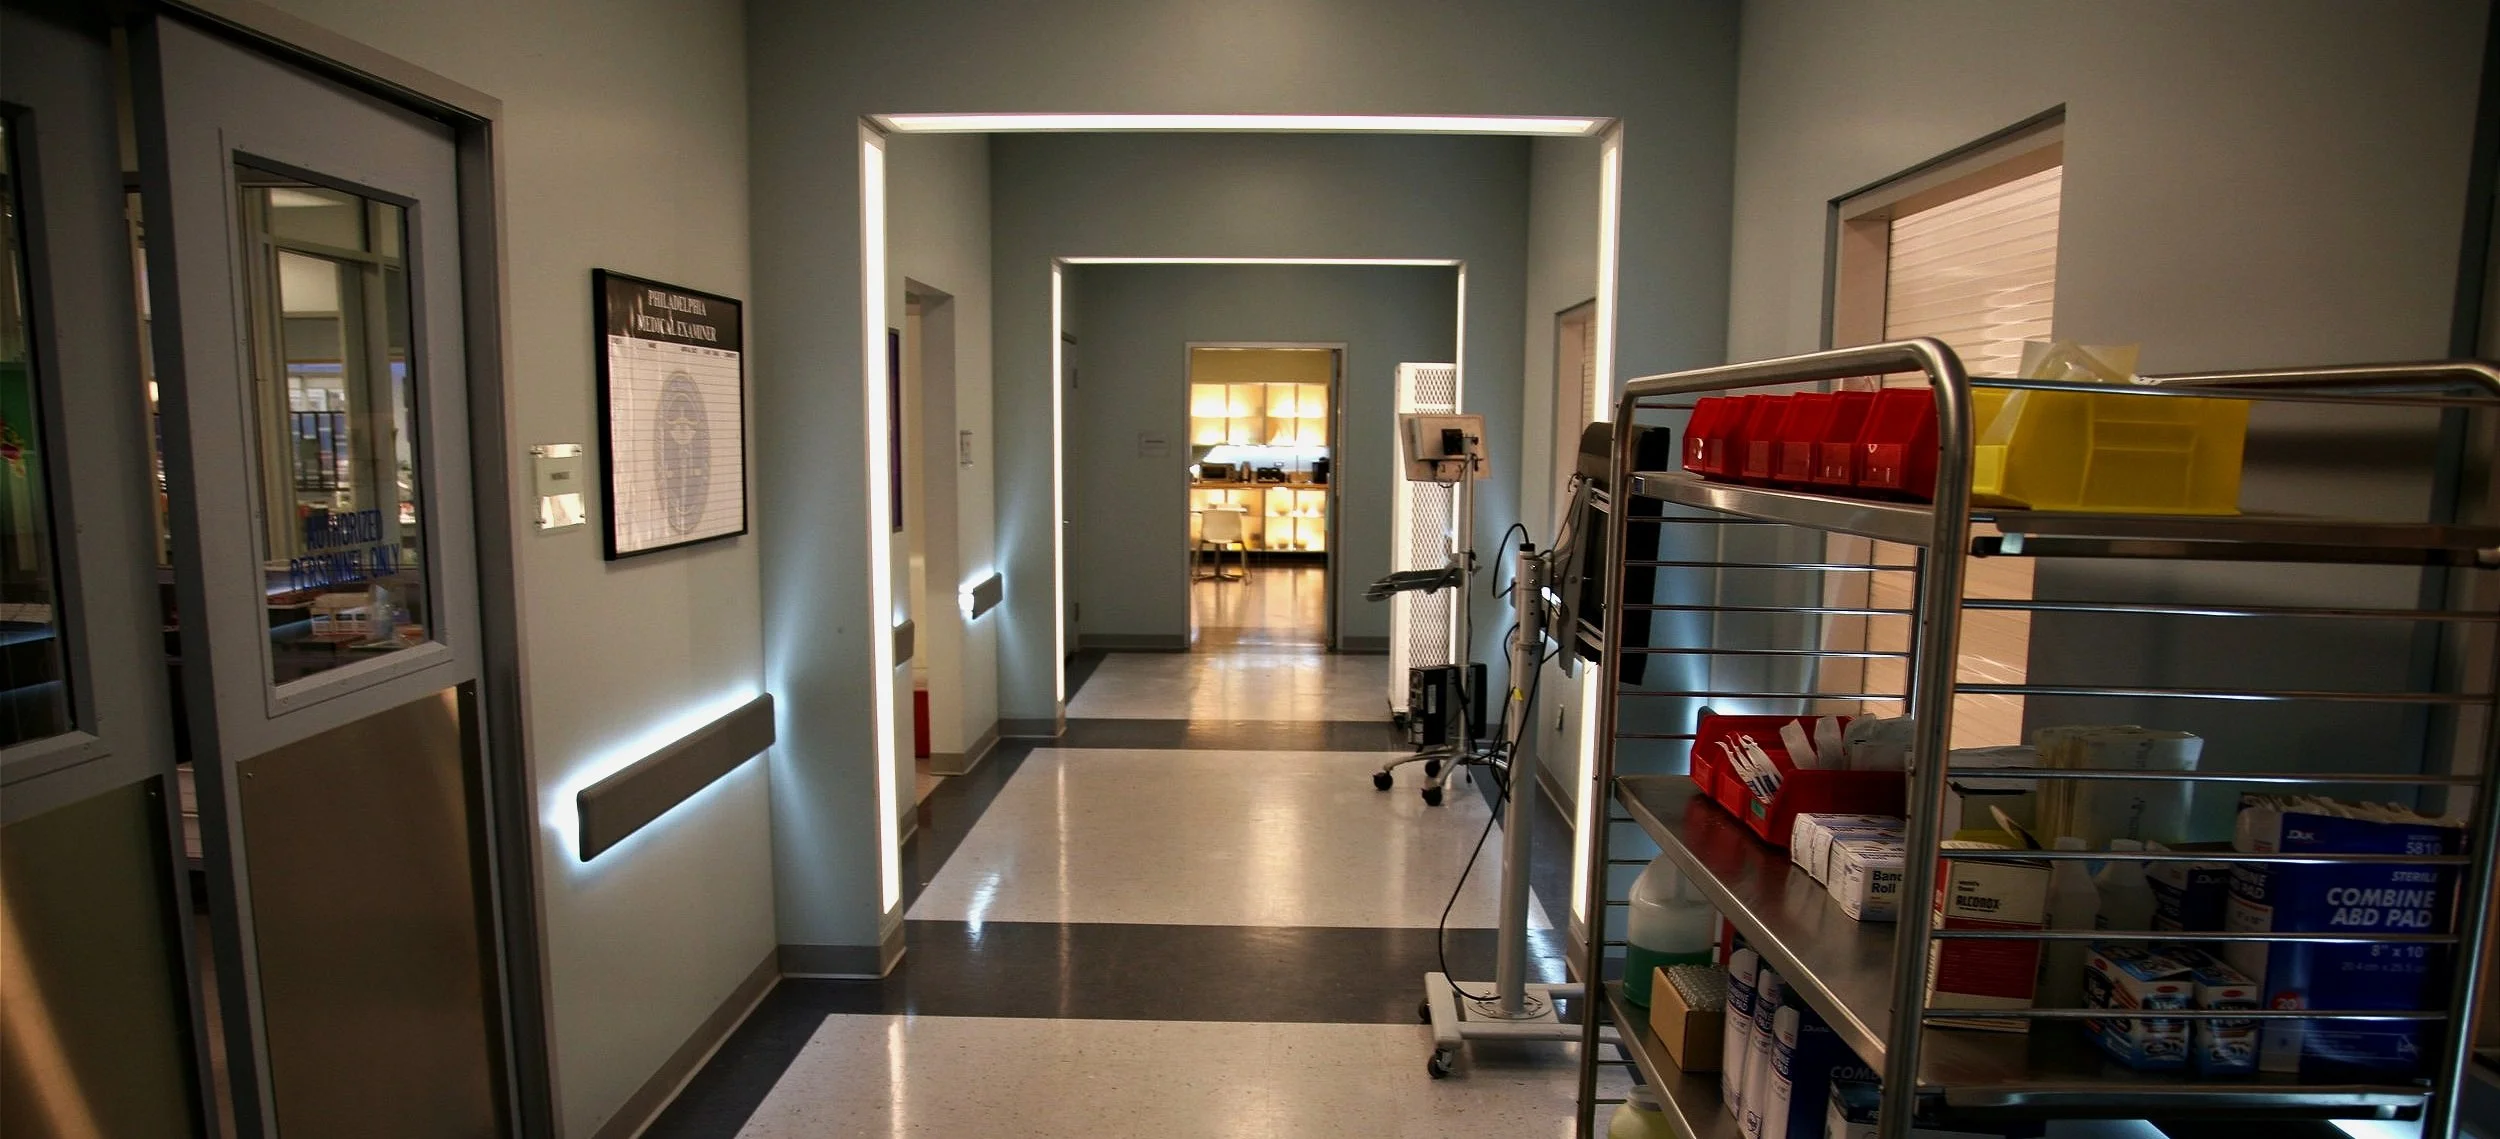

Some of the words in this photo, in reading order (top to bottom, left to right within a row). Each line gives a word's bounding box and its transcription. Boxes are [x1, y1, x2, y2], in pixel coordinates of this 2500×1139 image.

[648, 289, 707, 317] PHILADELPHIA
[637, 313, 677, 336] MEDICAL
[677, 321, 718, 343] EXAMINER
[307, 509, 384, 551] AUTHORIZED
[290, 550, 368, 592] PERSONNEL
[370, 543, 400, 579] ONLY
[2405, 841, 2442, 855] 5810
[1871, 881, 1896, 894] Roll
[2326, 886, 2437, 909] COMBINE
[2329, 907, 2381, 927] ABD
[2385, 908, 2434, 928] PAD
